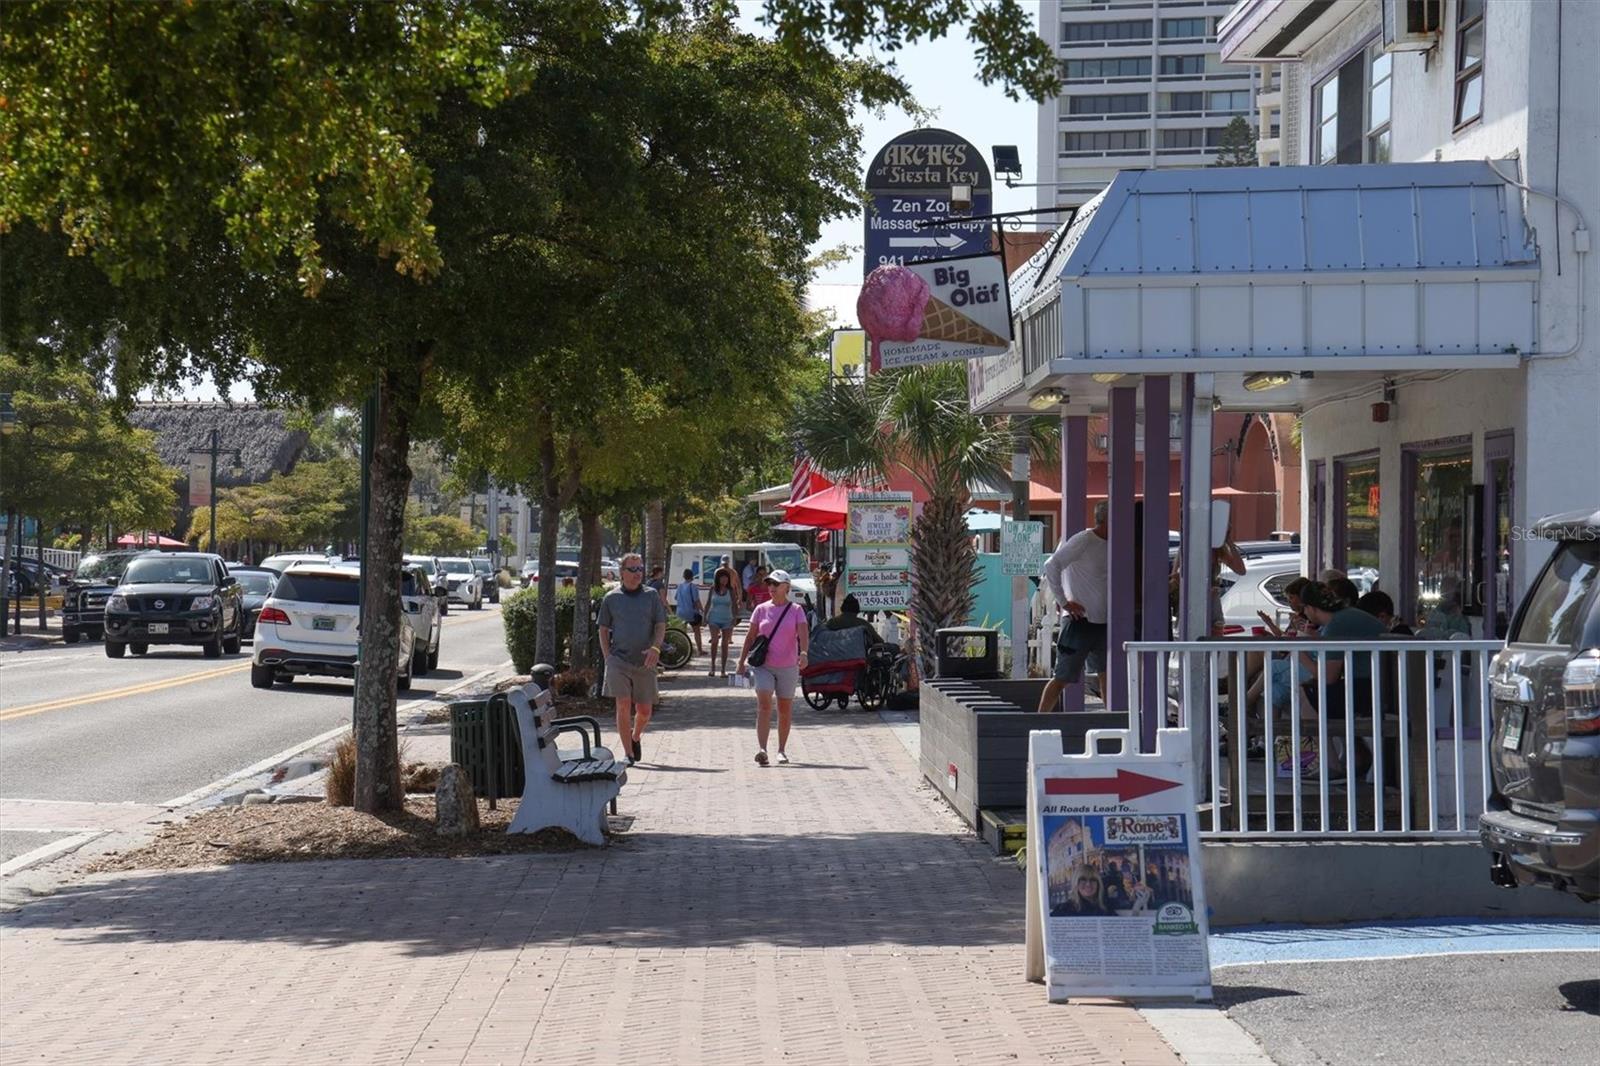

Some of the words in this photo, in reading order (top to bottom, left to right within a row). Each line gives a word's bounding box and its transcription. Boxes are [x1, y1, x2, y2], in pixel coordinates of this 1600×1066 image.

[884, 144, 967, 166] ARCHES
[876, 167, 889, 176] of
[888, 166, 940, 183] Siesta
[946, 166, 979, 186] Key
[892, 199, 921, 213] Zen
[934, 266, 971, 288] Big
[951, 283, 1000, 307] Oläf
[884, 342, 941, 356] HOMEMADE
[885, 357, 901, 366] ICE
[904, 353, 938, 363] CREAM
[953, 347, 985, 357] CONES
[1042, 805, 1057, 813] All
[1060, 805, 1090, 813] Roads
[1093, 805, 1117, 813] Lead
[1121, 816, 1164, 835] Rome
